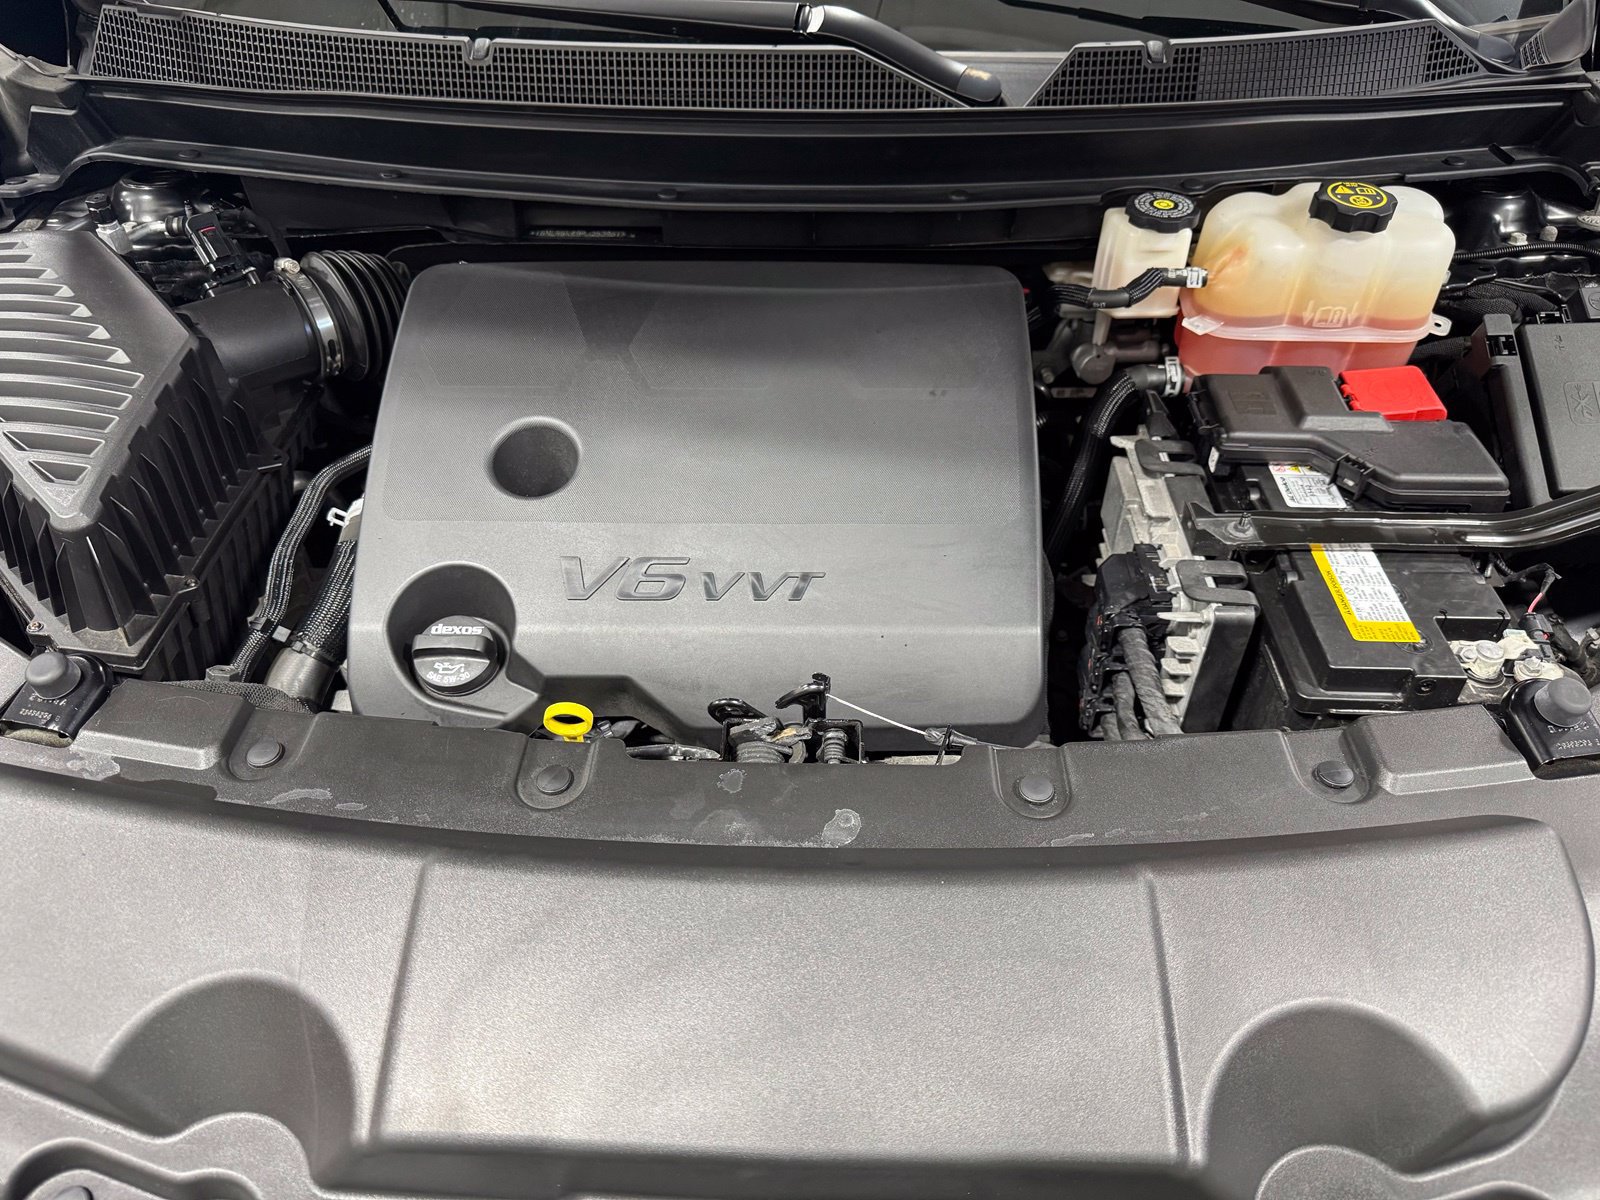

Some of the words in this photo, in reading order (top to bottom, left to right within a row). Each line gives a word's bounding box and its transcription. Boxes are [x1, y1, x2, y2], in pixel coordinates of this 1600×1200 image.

[560, 556, 691, 601] V6
[700, 572, 826, 601] VVT
[430, 623, 485, 635] dexos
[426, 671, 442, 682] SAE
[442, 671, 471, 683] 5W-30
